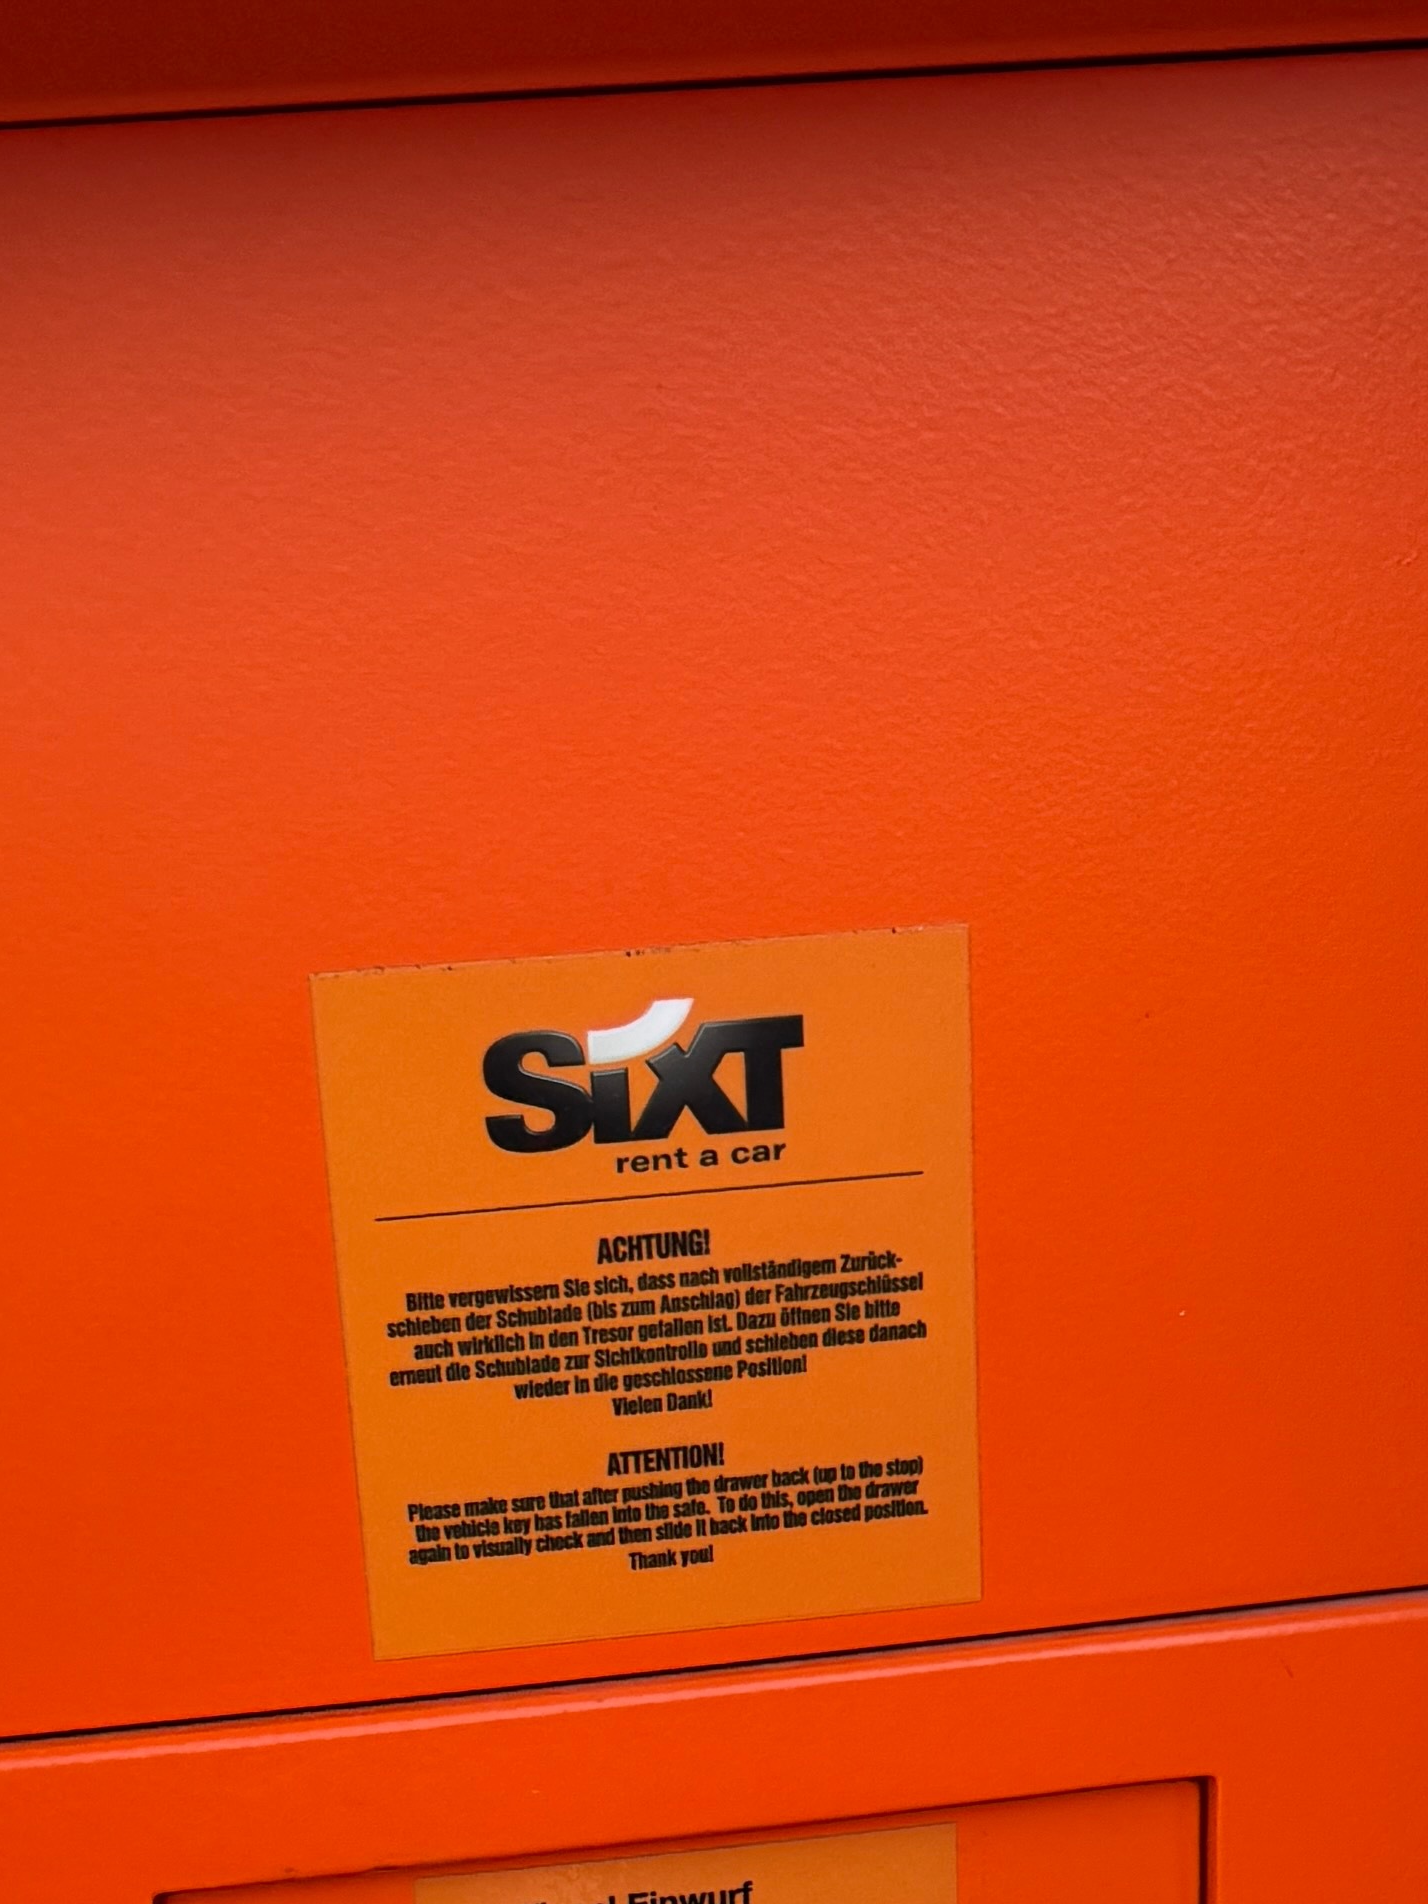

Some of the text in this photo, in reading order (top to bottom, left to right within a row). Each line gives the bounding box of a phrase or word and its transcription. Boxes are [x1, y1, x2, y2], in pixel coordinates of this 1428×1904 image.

[617, 1143, 786, 1174] rent a car
[597, 1228, 710, 1265] ACHTUNG!
[387, 1271, 923, 1339] schieben der Schublade (bis zum Anschlag) der Fahrzeugschlüssel
[406, 1250, 902, 1312] Bitte vergewissern Sie sich, dass nach vollständigem Zurück-
[389, 1319, 927, 1387] erneut die Schublade zur Sichtkontrolle und schieben diese danach
[414, 1299, 900, 1361] auch wirklich in den Tresor gefallen ist. Dazu öffnen Sie bitte
[514, 1354, 807, 1400] wieder in die geschlossene Position!
[612, 1388, 712, 1417] Vielen Dank!
[408, 1455, 923, 1523] Please make sure that after pushing the drawer back (up to the stop)
[607, 1442, 724, 1477] ATTENTION!
[409, 1498, 928, 1566] again to visually check and then slide it back into the closed position.
[415, 1479, 919, 1543] the vehicle key has fallen into the safe. To do this, open the drawer
[628, 1544, 714, 1571] Thank you!
